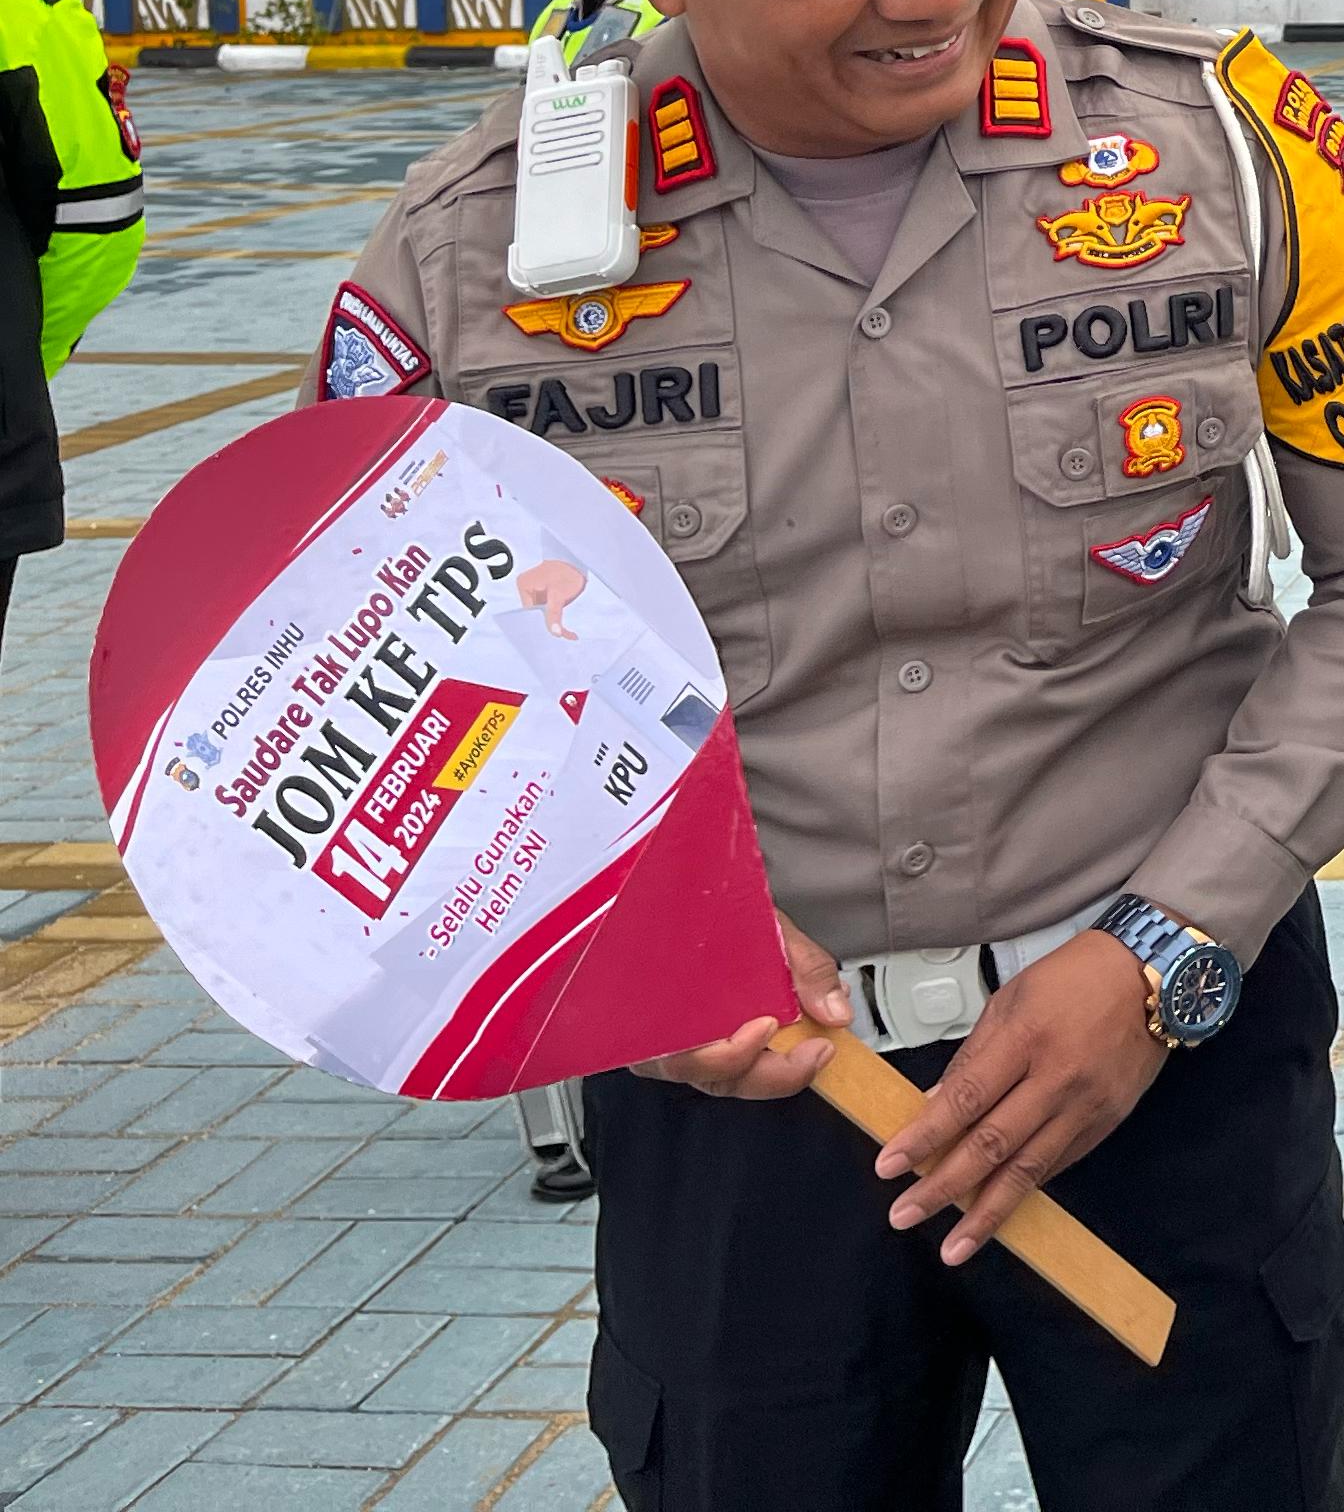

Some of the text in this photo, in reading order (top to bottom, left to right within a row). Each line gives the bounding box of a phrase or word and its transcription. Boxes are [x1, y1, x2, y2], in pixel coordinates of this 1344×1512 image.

[1020, 285, 1234, 372] POLRI
[487, 362, 720, 438] FAJRI
[211, 622, 305, 740] POLRES INHU
[214, 703, 314, 818] Saudare
[328, 592, 393, 662] Lupo
[251, 520, 514, 869] JOM KE TPS
[364, 708, 452, 824] FEBRUARI
[452, 709, 507, 783] #AyoKeTPS
[603, 741, 649, 806] KPU
[330, 818, 409, 902] 14
[393, 789, 442, 850] 2024
[431, 877, 483, 948] Selalu
[474, 782, 544, 876] Gunakan
[475, 830, 548, 933] Helm SNI
